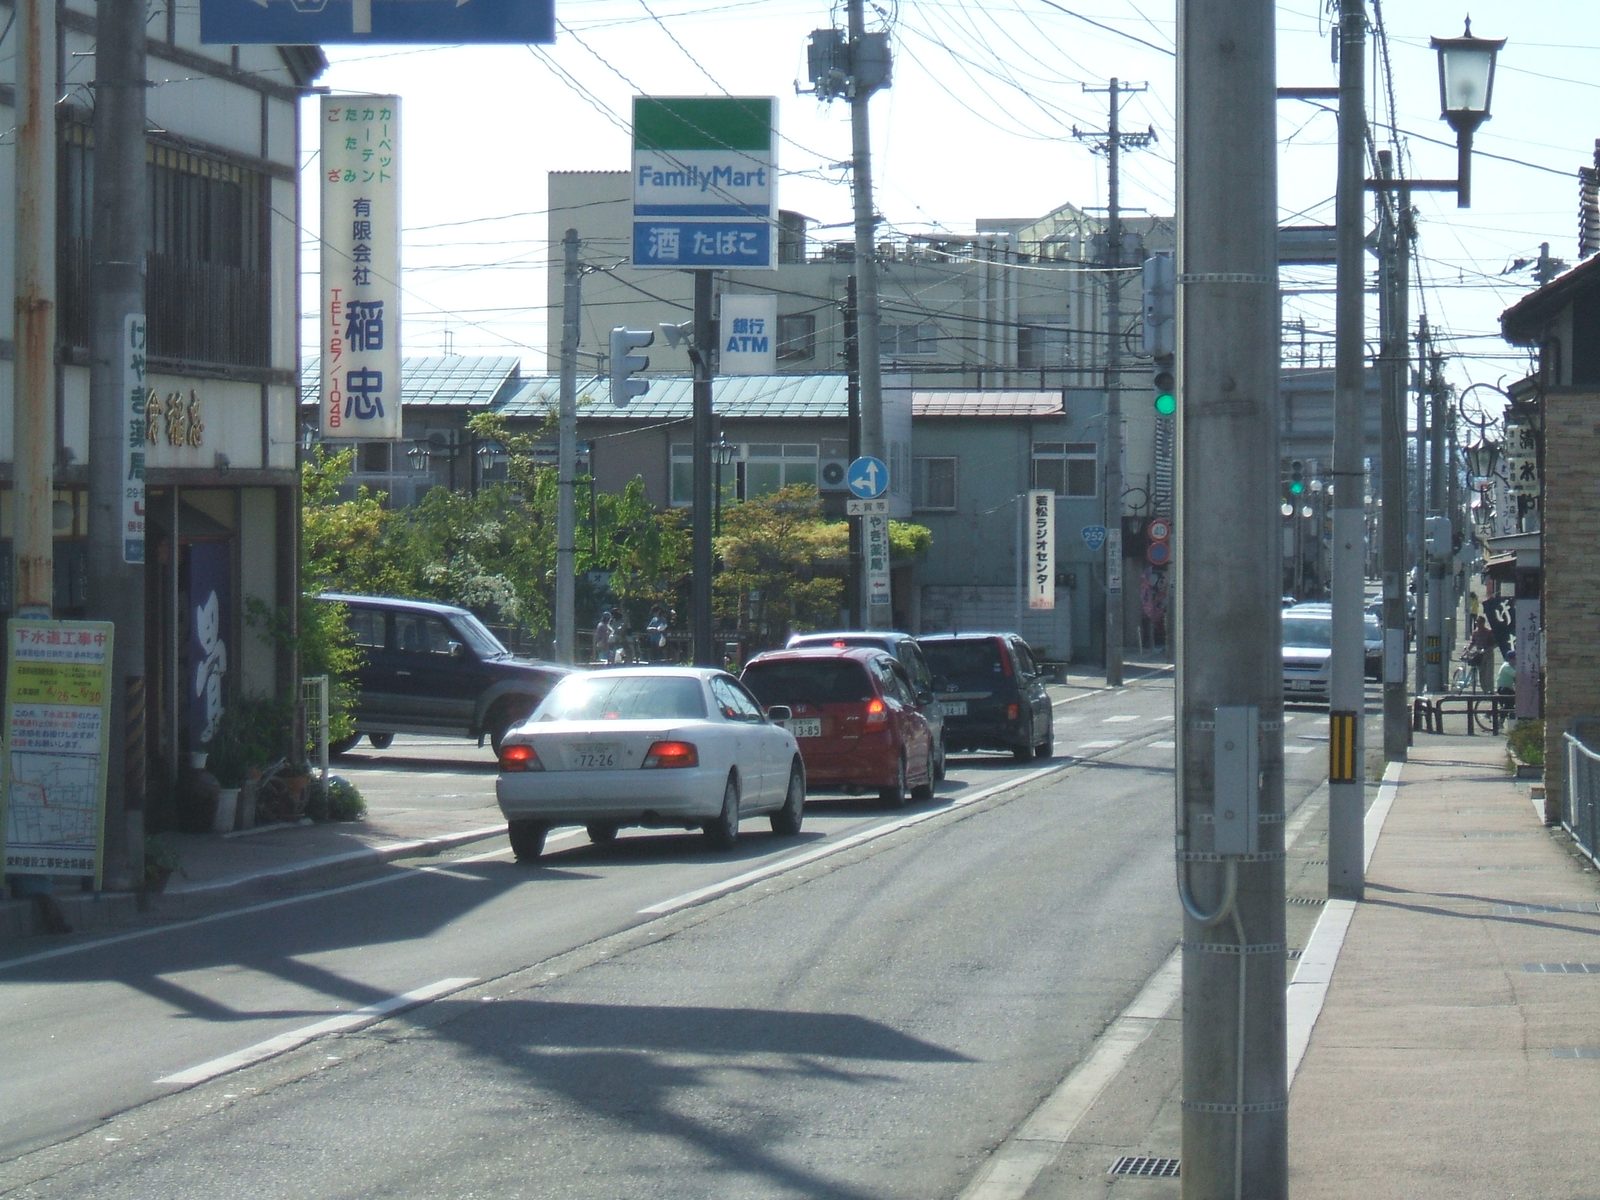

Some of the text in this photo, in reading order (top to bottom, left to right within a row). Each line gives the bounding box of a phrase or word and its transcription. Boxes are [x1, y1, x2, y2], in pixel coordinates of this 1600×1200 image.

[328, 108, 341, 182] ござ
[344, 107, 357, 183] たたみ
[362, 107, 375, 182] カーテン
[379, 107, 391, 183] カーペット
[639, 165, 766, 192] FamilyMart
[352, 197, 371, 286] 有限会社
[649, 227, 757, 259] 酒 たばこ
[726, 336, 769, 352] ATM
[733, 317, 765, 334] 銀行
[345, 300, 384, 419] 稲忠
[1035, 495, 1048, 594] 若松ラジオセンター
[1084, 531, 1104, 541] 252
[16, 629, 107, 648] 下水道工事中
[580, 753, 614, 767] 72-26
